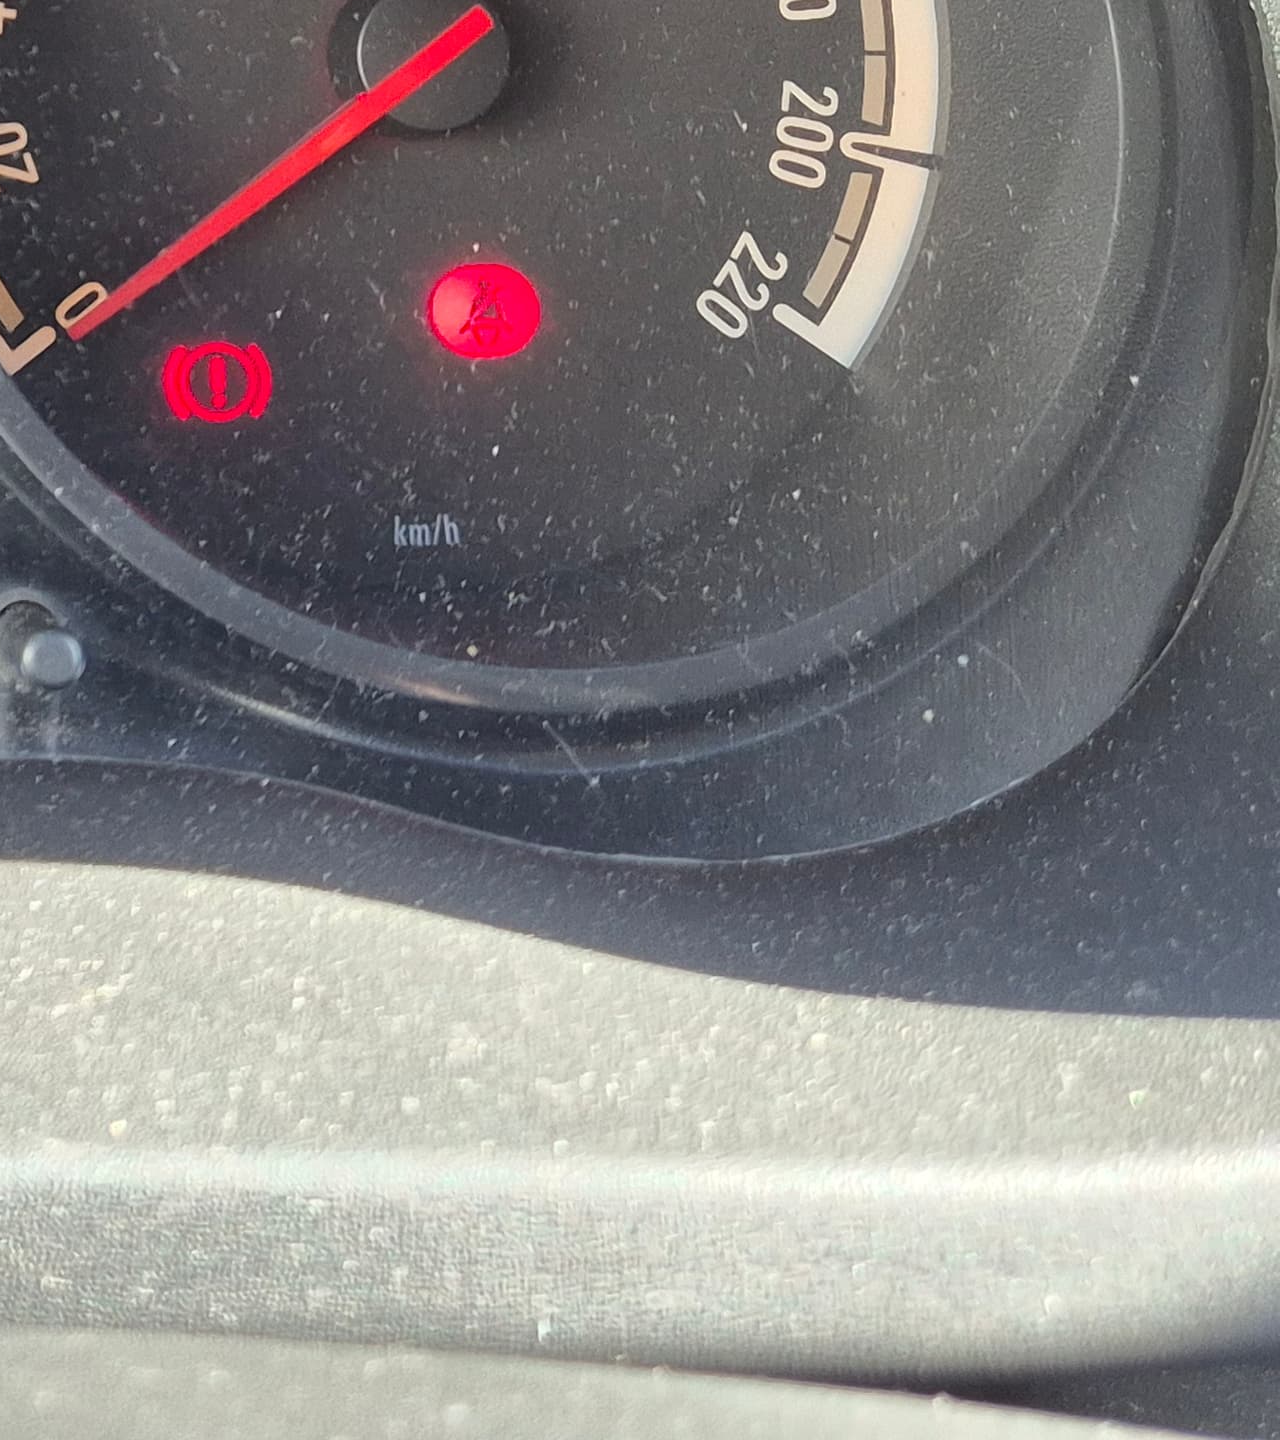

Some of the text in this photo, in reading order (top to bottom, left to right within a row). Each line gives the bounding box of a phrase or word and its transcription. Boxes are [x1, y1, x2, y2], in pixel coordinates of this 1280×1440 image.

[768, 80, 839, 189] 200
[696, 231, 789, 339] 220
[393, 513, 461, 547] km/h
